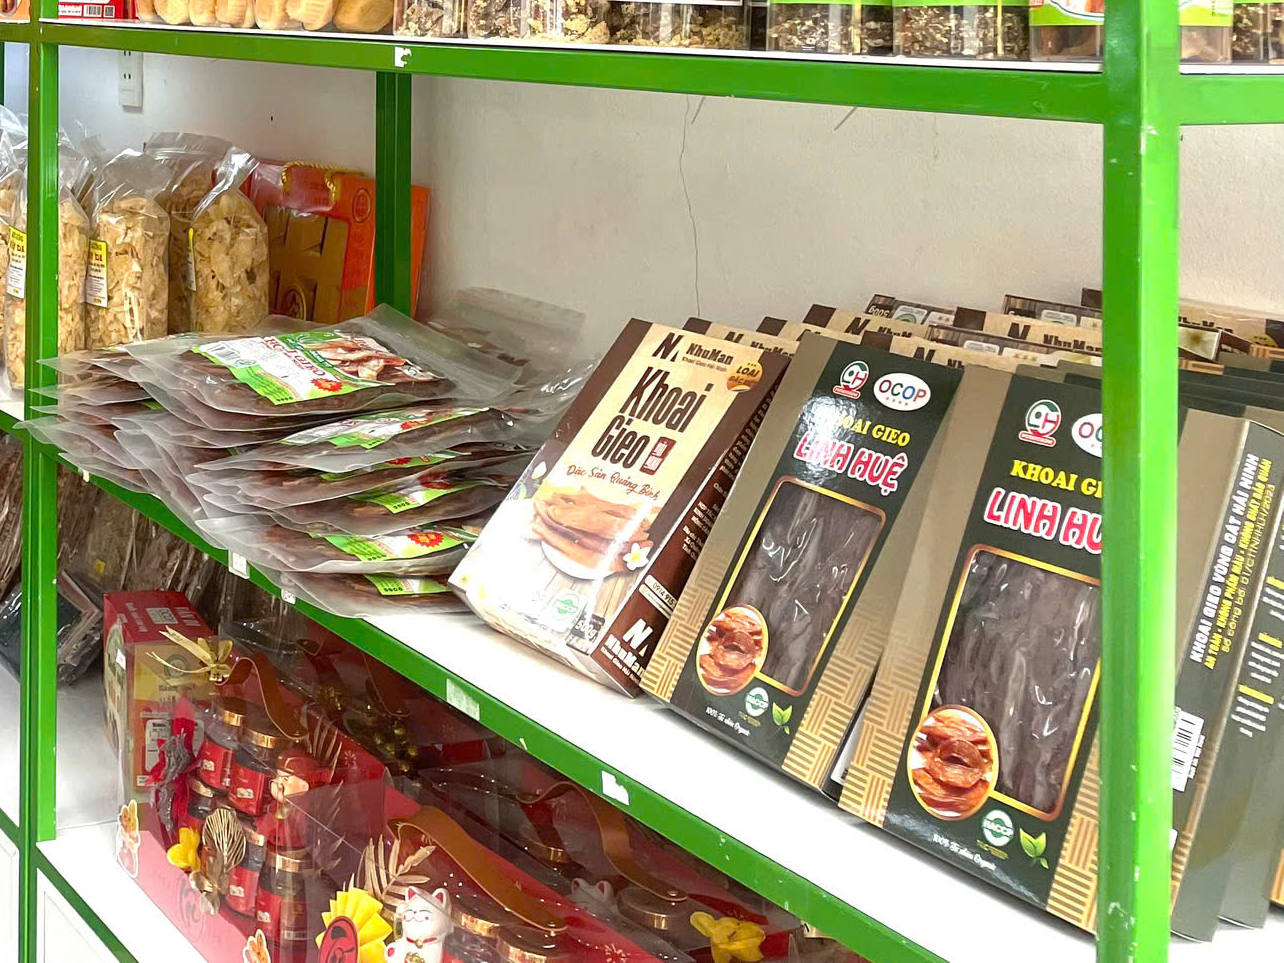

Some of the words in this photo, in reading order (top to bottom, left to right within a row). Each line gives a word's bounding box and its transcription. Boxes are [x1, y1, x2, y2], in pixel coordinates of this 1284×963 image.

[619, 366, 714, 434] Khoai
[879, 379, 927, 403] OCOP
[591, 414, 650, 470] Gieo
[872, 424, 911, 447] GIEO
[848, 448, 908, 495] HUỆ
[1010, 459, 1078, 491] KHOAI
[1081, 477, 1102, 499] GI
[984, 487, 1061, 540] LINH
[1059, 507, 1102, 554] HU
[1190, 619, 1213, 663] KHOAI
[1239, 453, 1260, 488] NINH
[652, 582, 665, 597] 0914
